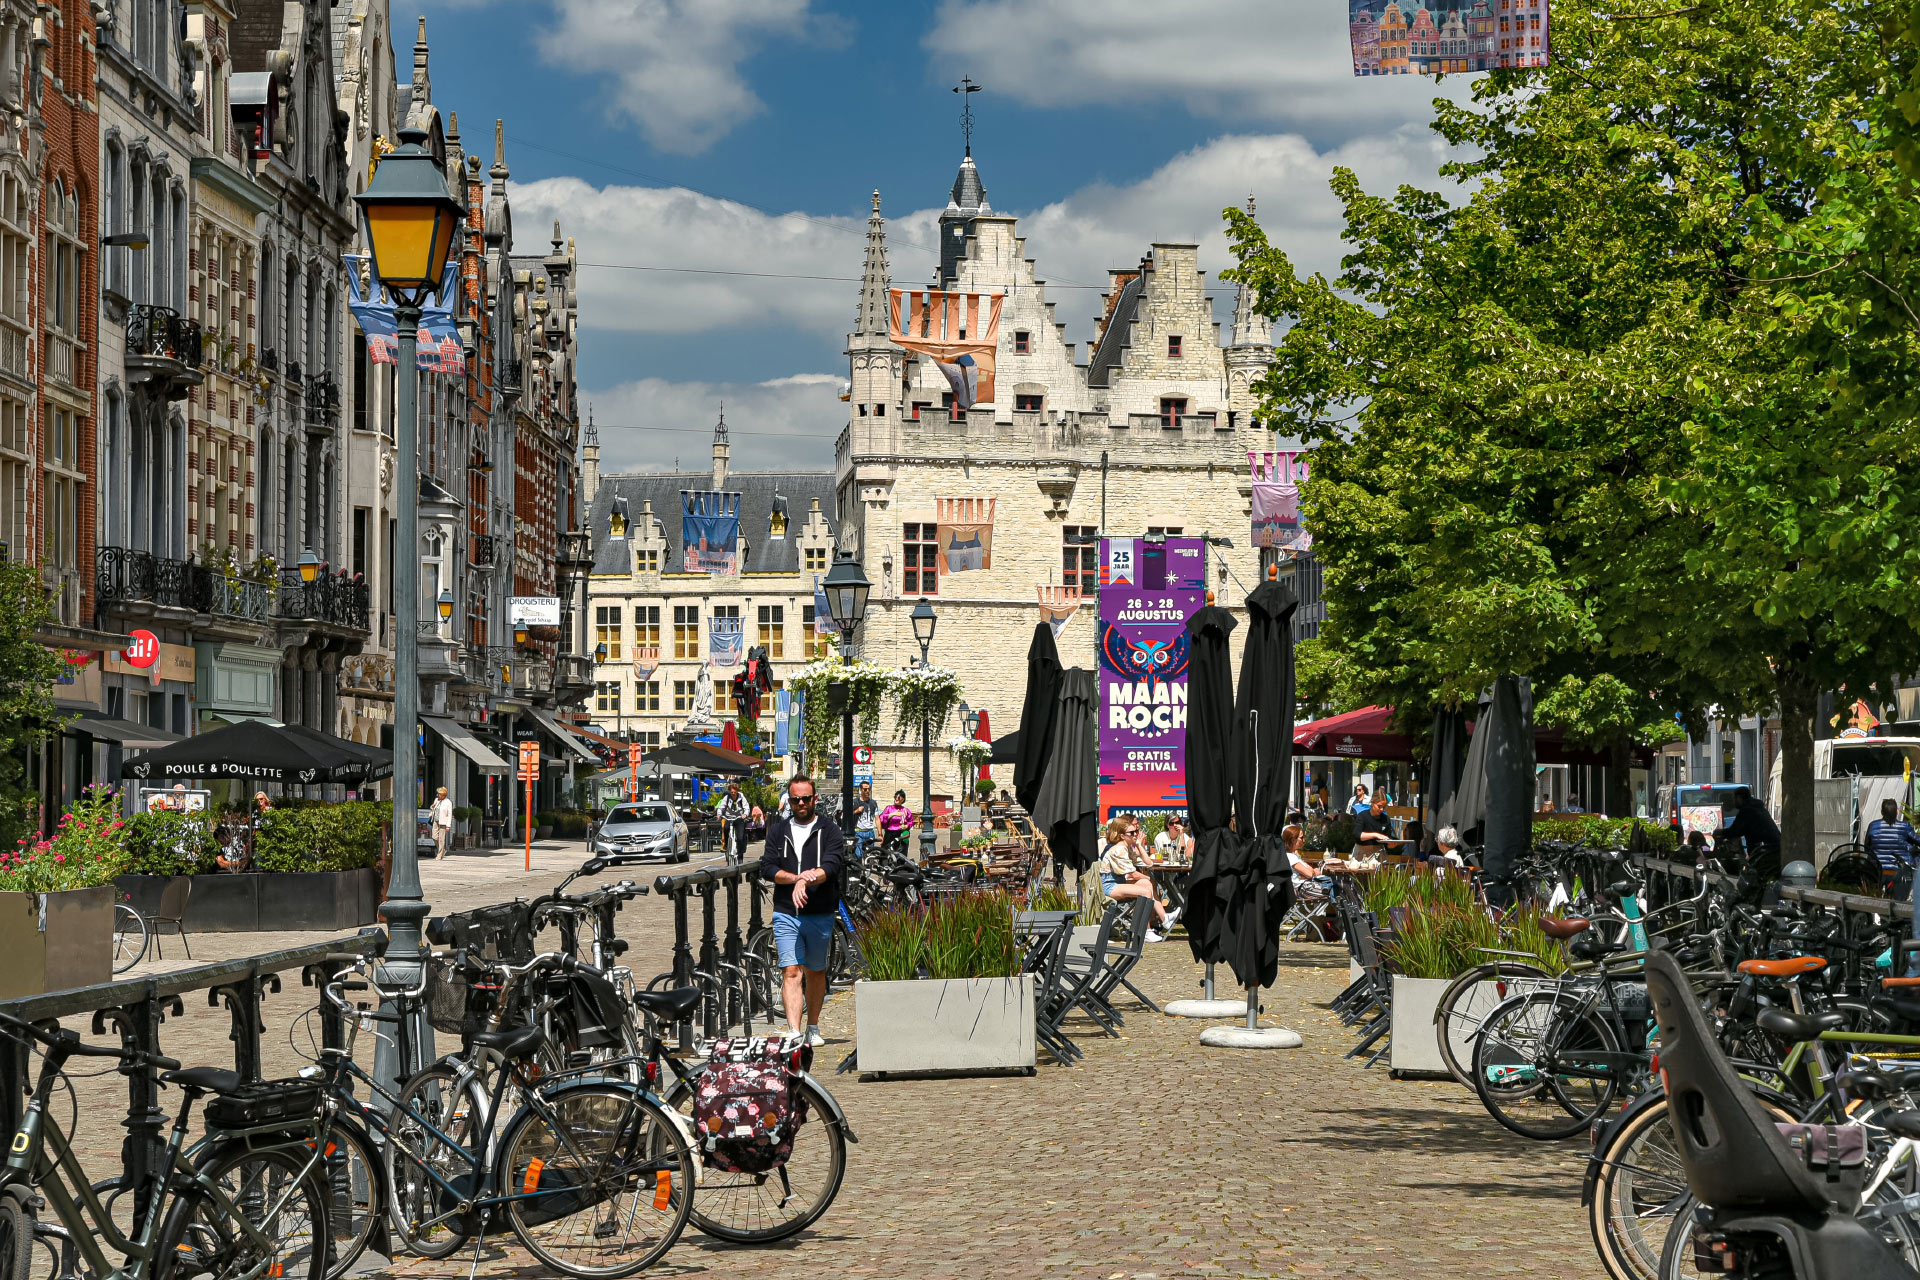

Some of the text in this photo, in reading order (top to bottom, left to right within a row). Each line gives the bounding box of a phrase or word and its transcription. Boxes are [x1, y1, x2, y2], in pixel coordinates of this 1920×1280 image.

[1113, 552, 1130, 562] 25
[1127, 598, 1142, 608] 26
[1158, 598, 1174, 608] 28
[1117, 610, 1184, 620] AUGUSTUS
[126, 638, 153, 658] di!
[1109, 682, 1188, 705] MAAN
[1109, 705, 1188, 730] ROCK
[1128, 751, 1171, 760] GRATIS
[166, 763, 283, 778] POULE & POULETTE
[1123, 762, 1178, 772] FESTIVAL
